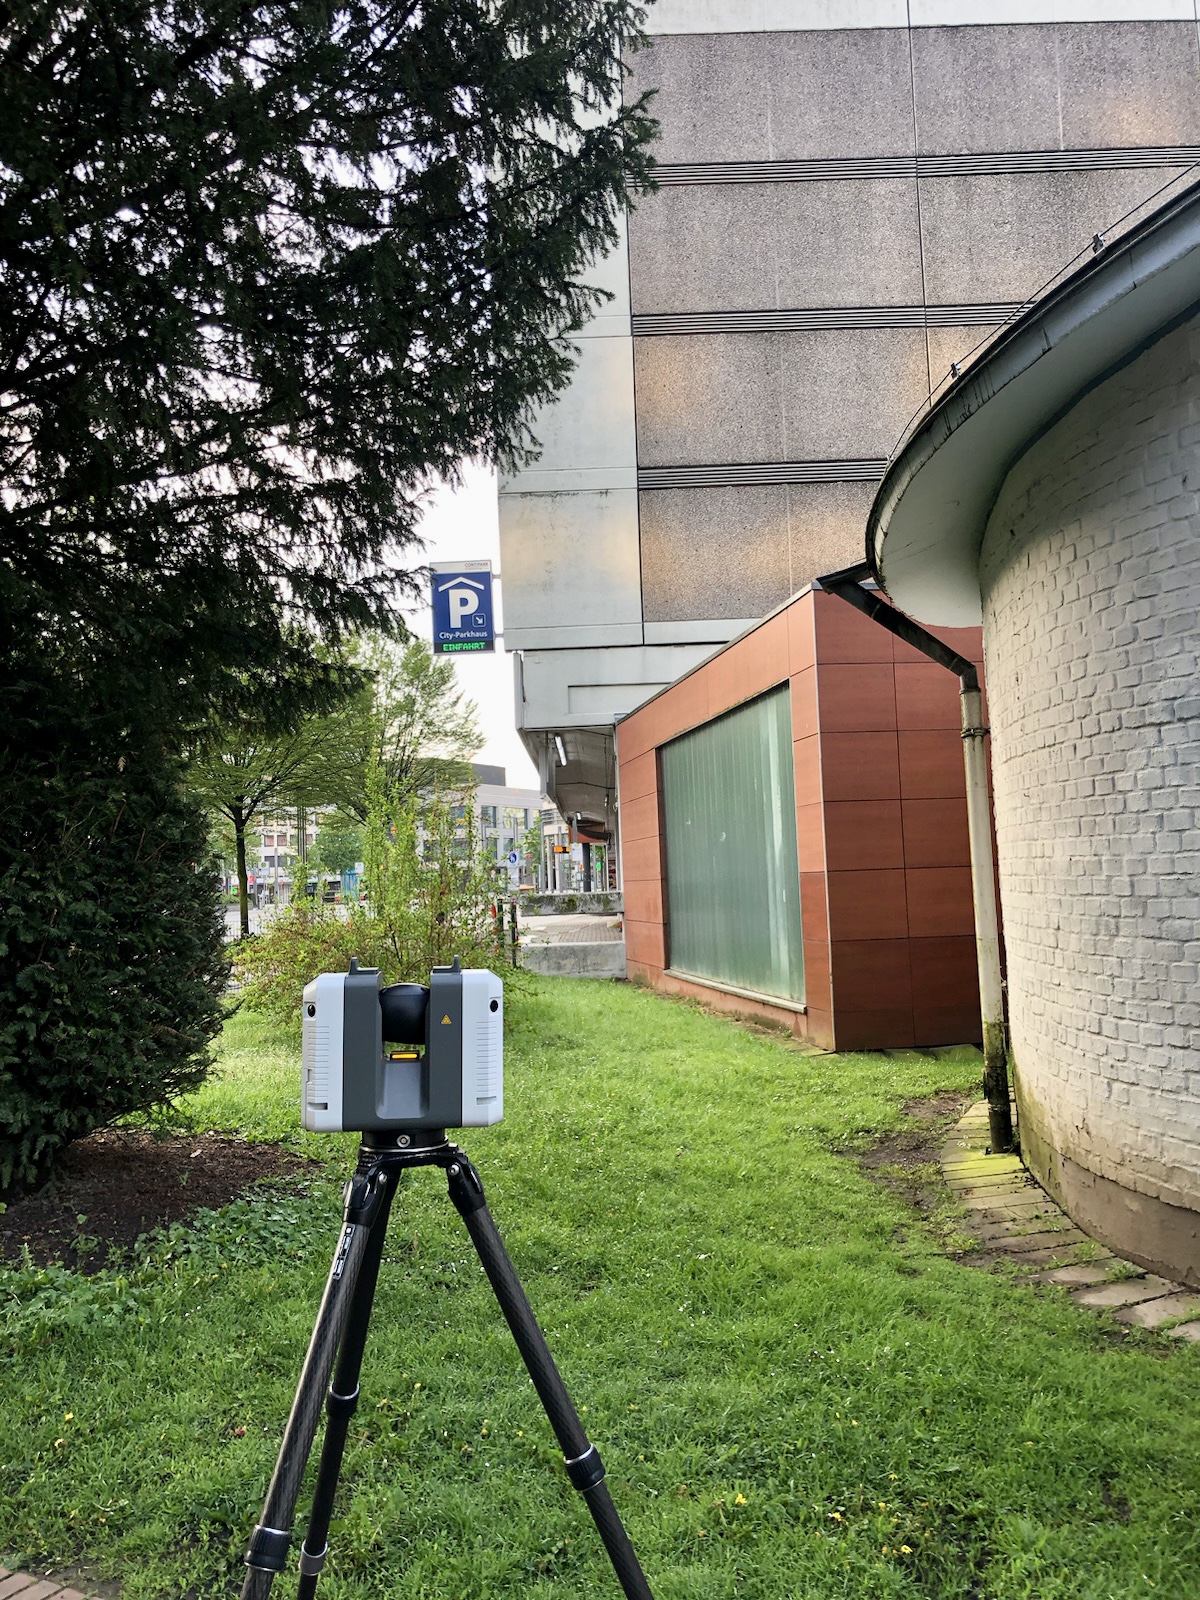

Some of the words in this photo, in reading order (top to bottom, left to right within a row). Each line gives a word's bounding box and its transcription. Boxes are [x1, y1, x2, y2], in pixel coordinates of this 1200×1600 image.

[448, 588, 479, 628] P
[438, 631, 488, 640] City-Parkhaus
[442, 642, 486, 652] EINFAHRT
